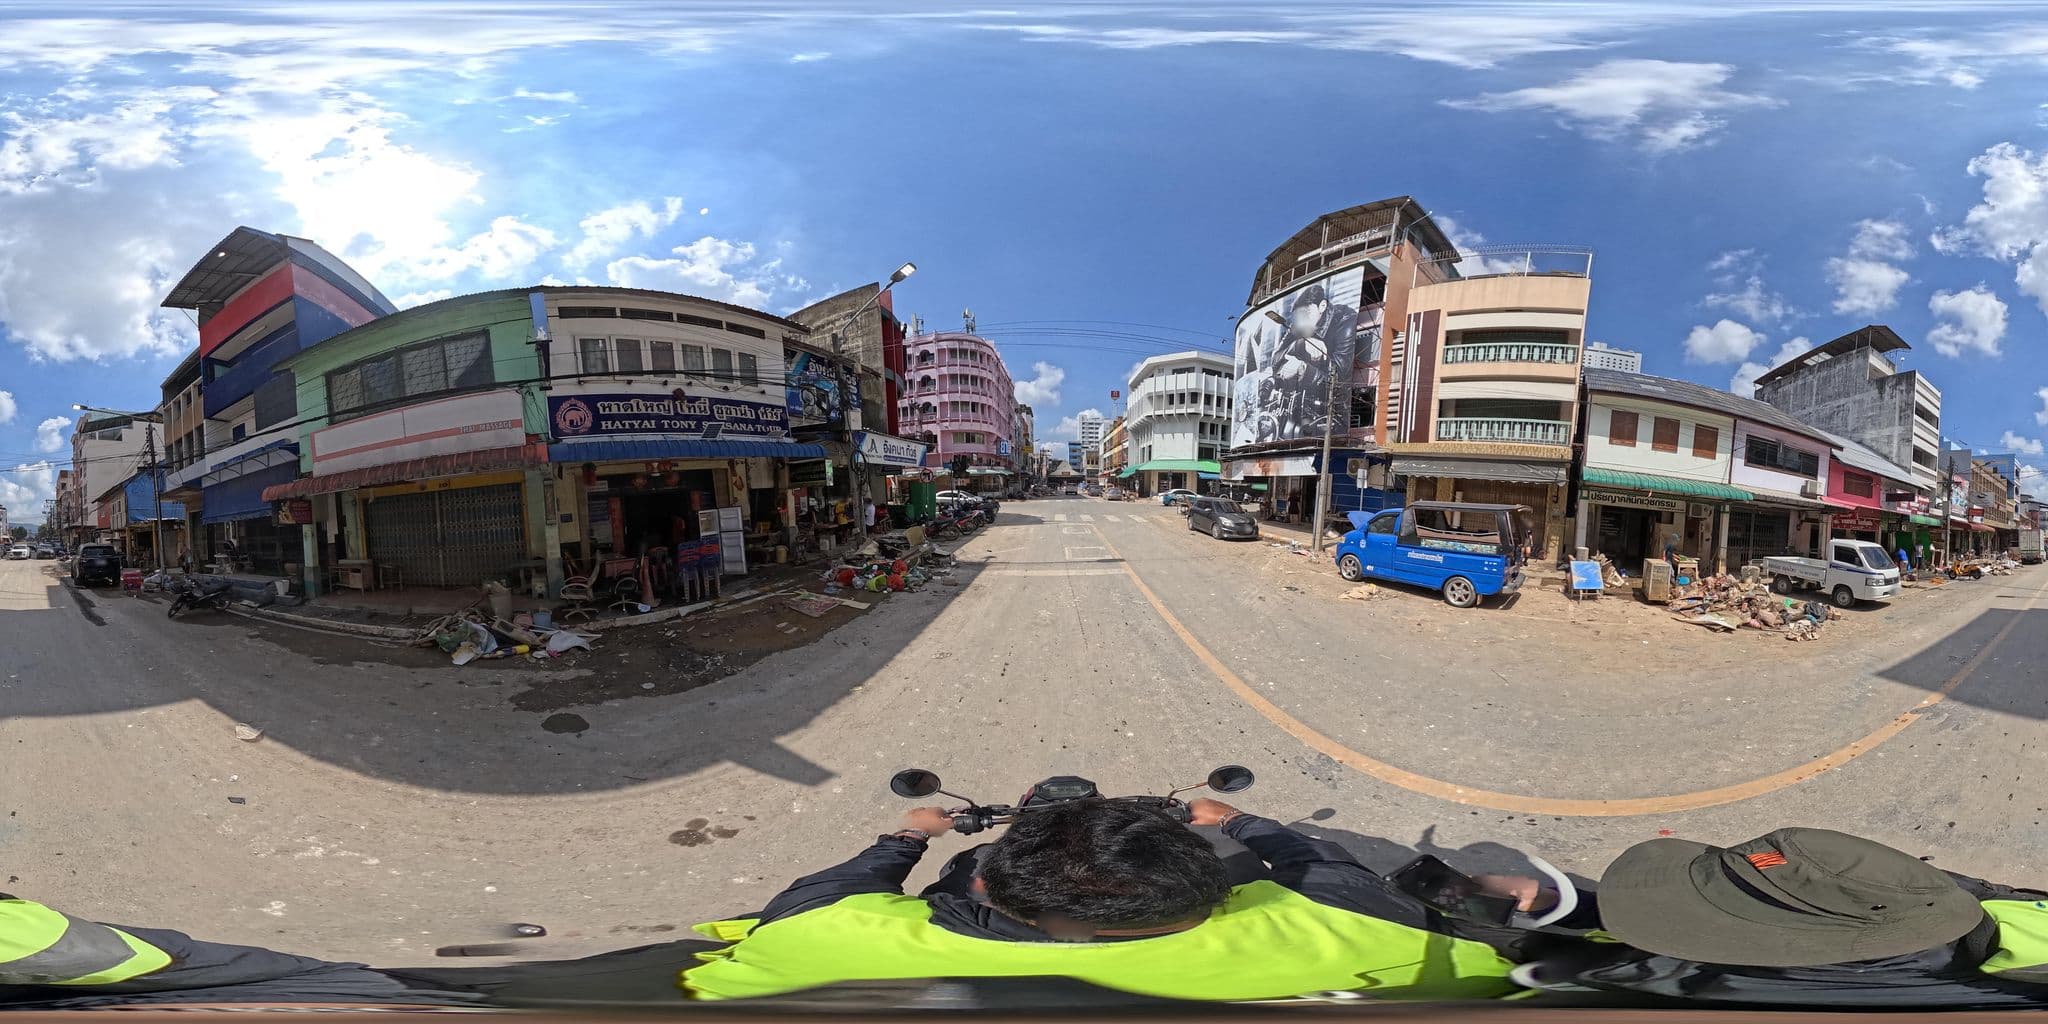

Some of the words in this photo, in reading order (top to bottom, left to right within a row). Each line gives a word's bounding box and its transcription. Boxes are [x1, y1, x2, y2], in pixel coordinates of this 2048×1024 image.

[598, 399, 674, 416] หาดใหญ่
[479, 420, 512, 431] MASSAGE
[601, 420, 656, 430] HATYAI
[661, 420, 696, 429] TONY
[702, 422, 754, 432] SSANA
